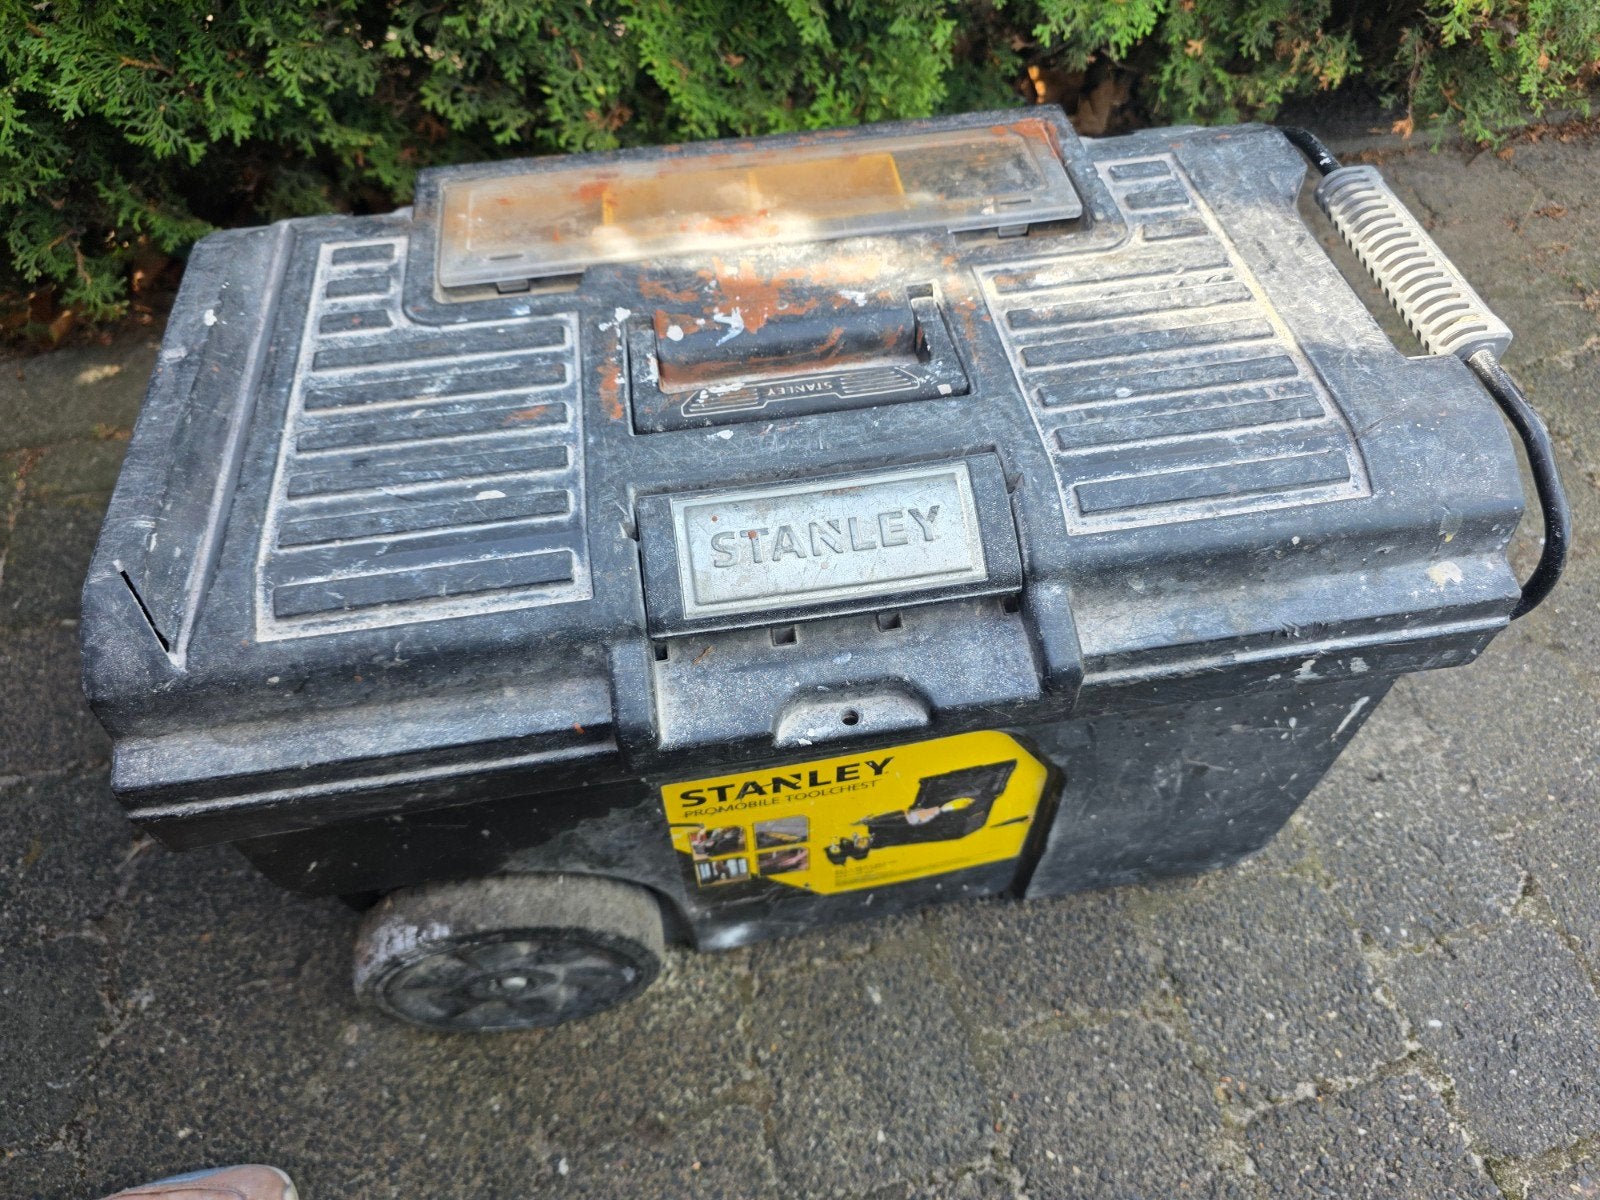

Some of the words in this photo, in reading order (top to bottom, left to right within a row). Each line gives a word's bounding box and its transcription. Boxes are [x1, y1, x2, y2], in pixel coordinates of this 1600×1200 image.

[767, 381, 832, 396] STANLEY
[710, 504, 940, 568] STANLEY
[680, 756, 894, 807] STANLEY
[684, 797, 782, 818] PROMOBILE
[784, 779, 879, 802] TOOLCHEST
